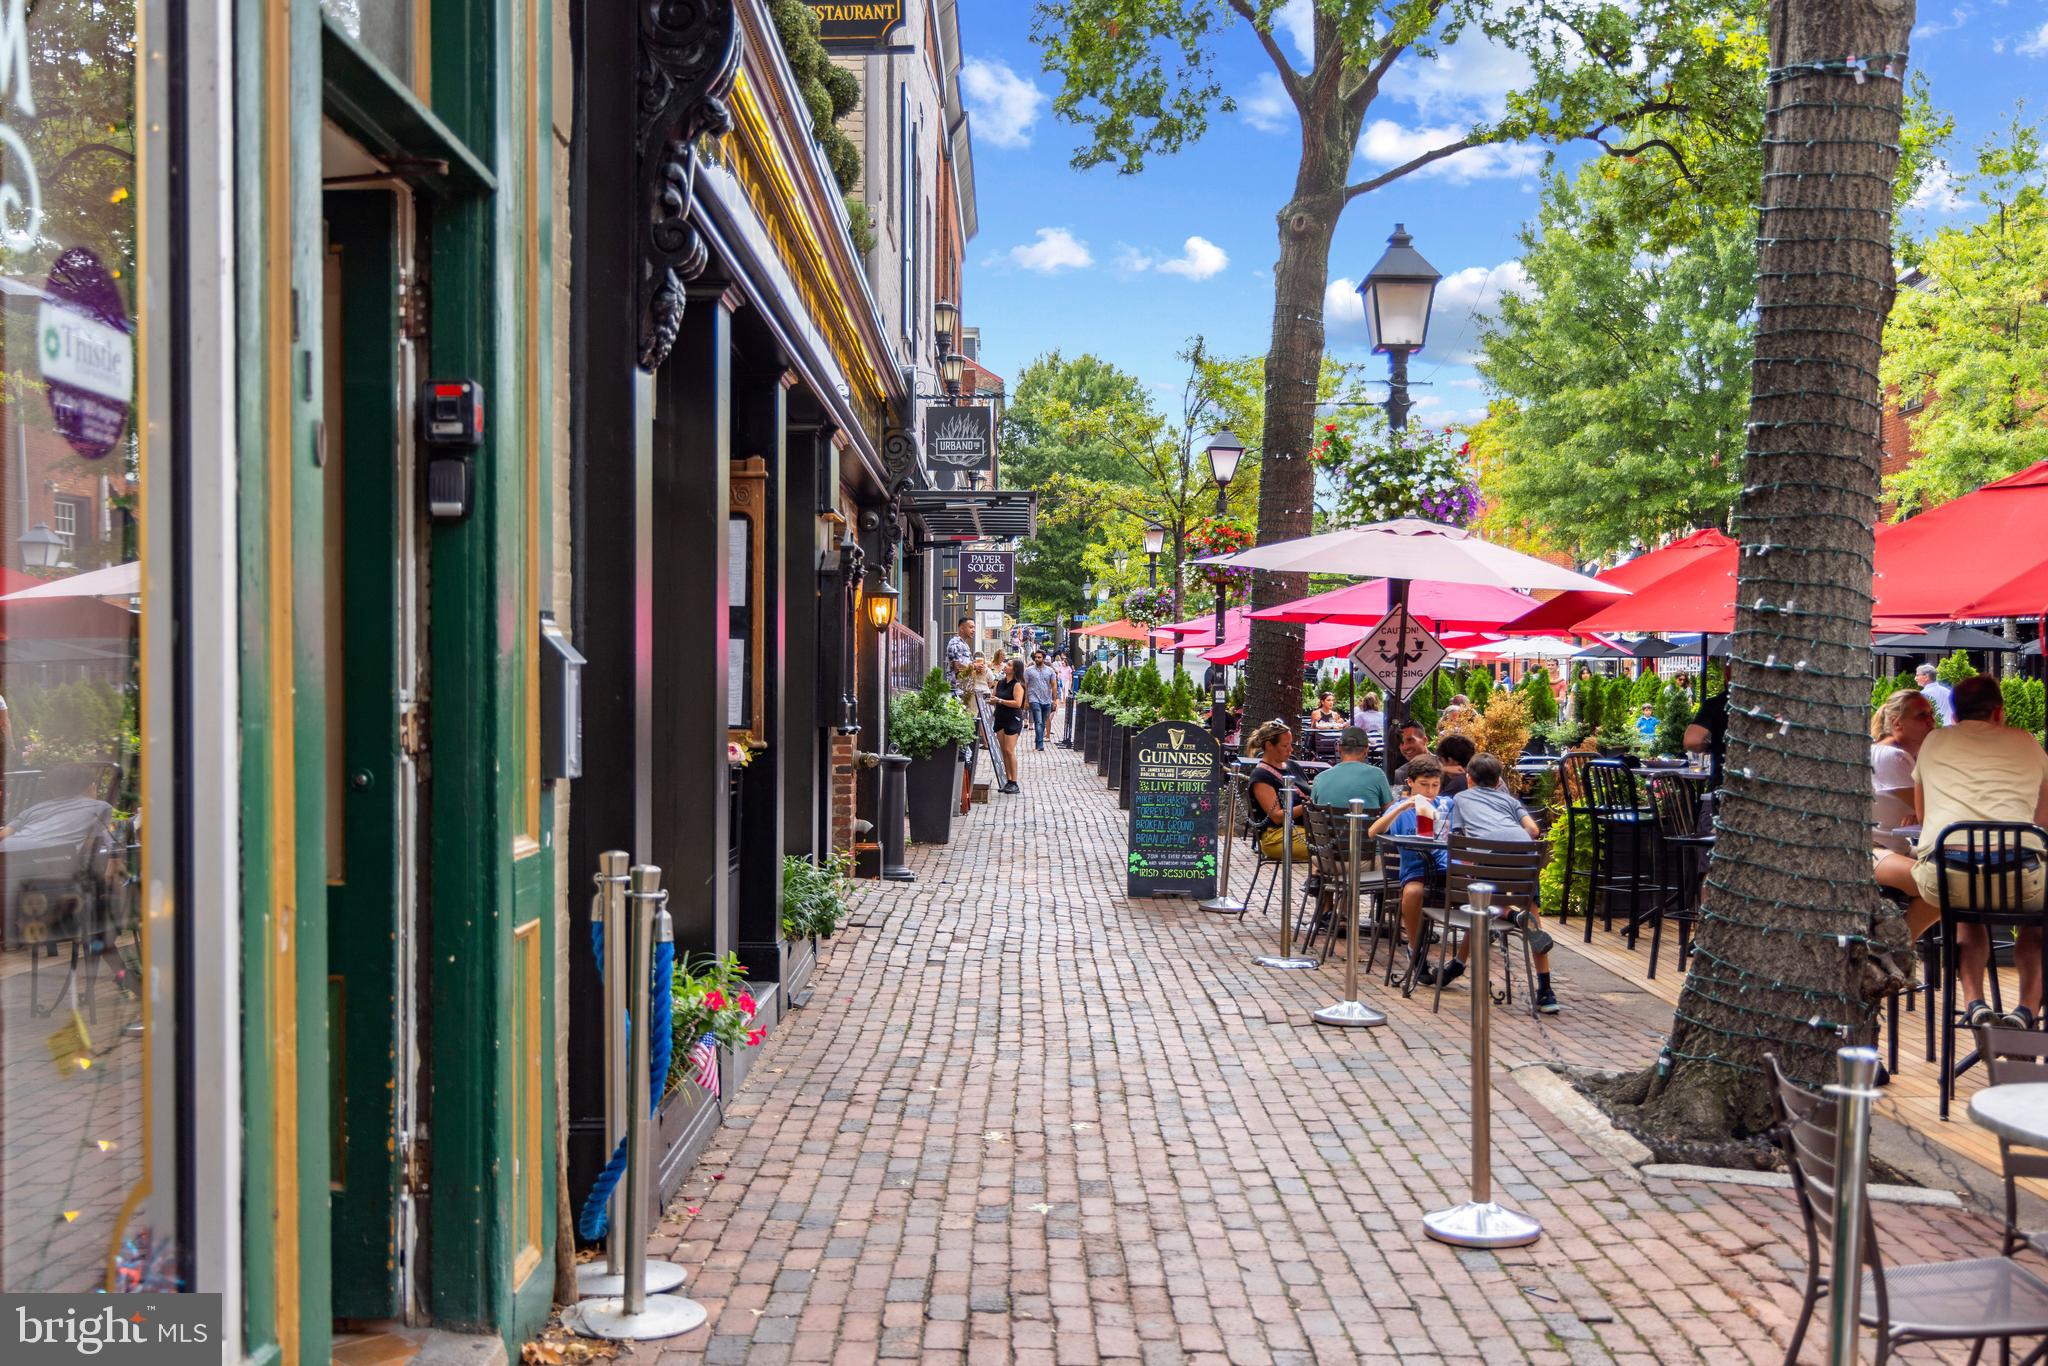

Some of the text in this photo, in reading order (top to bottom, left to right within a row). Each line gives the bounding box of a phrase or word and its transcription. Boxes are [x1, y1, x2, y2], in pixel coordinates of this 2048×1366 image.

[808, 4, 895, 21] STAURANT
[940, 441, 973, 450] URBANO
[971, 554, 1001, 563] PAPER
[967, 563, 1005, 572] SOURCE
[1379, 670, 1423, 678] CROSING
[1139, 749, 1213, 765] GUINNESS
[1151, 781, 1207, 792] LIVE MUSIC
[1136, 795, 1153, 804] MIKE
[1157, 795, 1189, 805] RICHARDS
[1136, 806, 1164, 816] TORREY
[1168, 820, 1194, 831] GROUND
[1136, 833, 1158, 843] BRIAN
[1160, 834, 1191, 846] GAFFNEY
